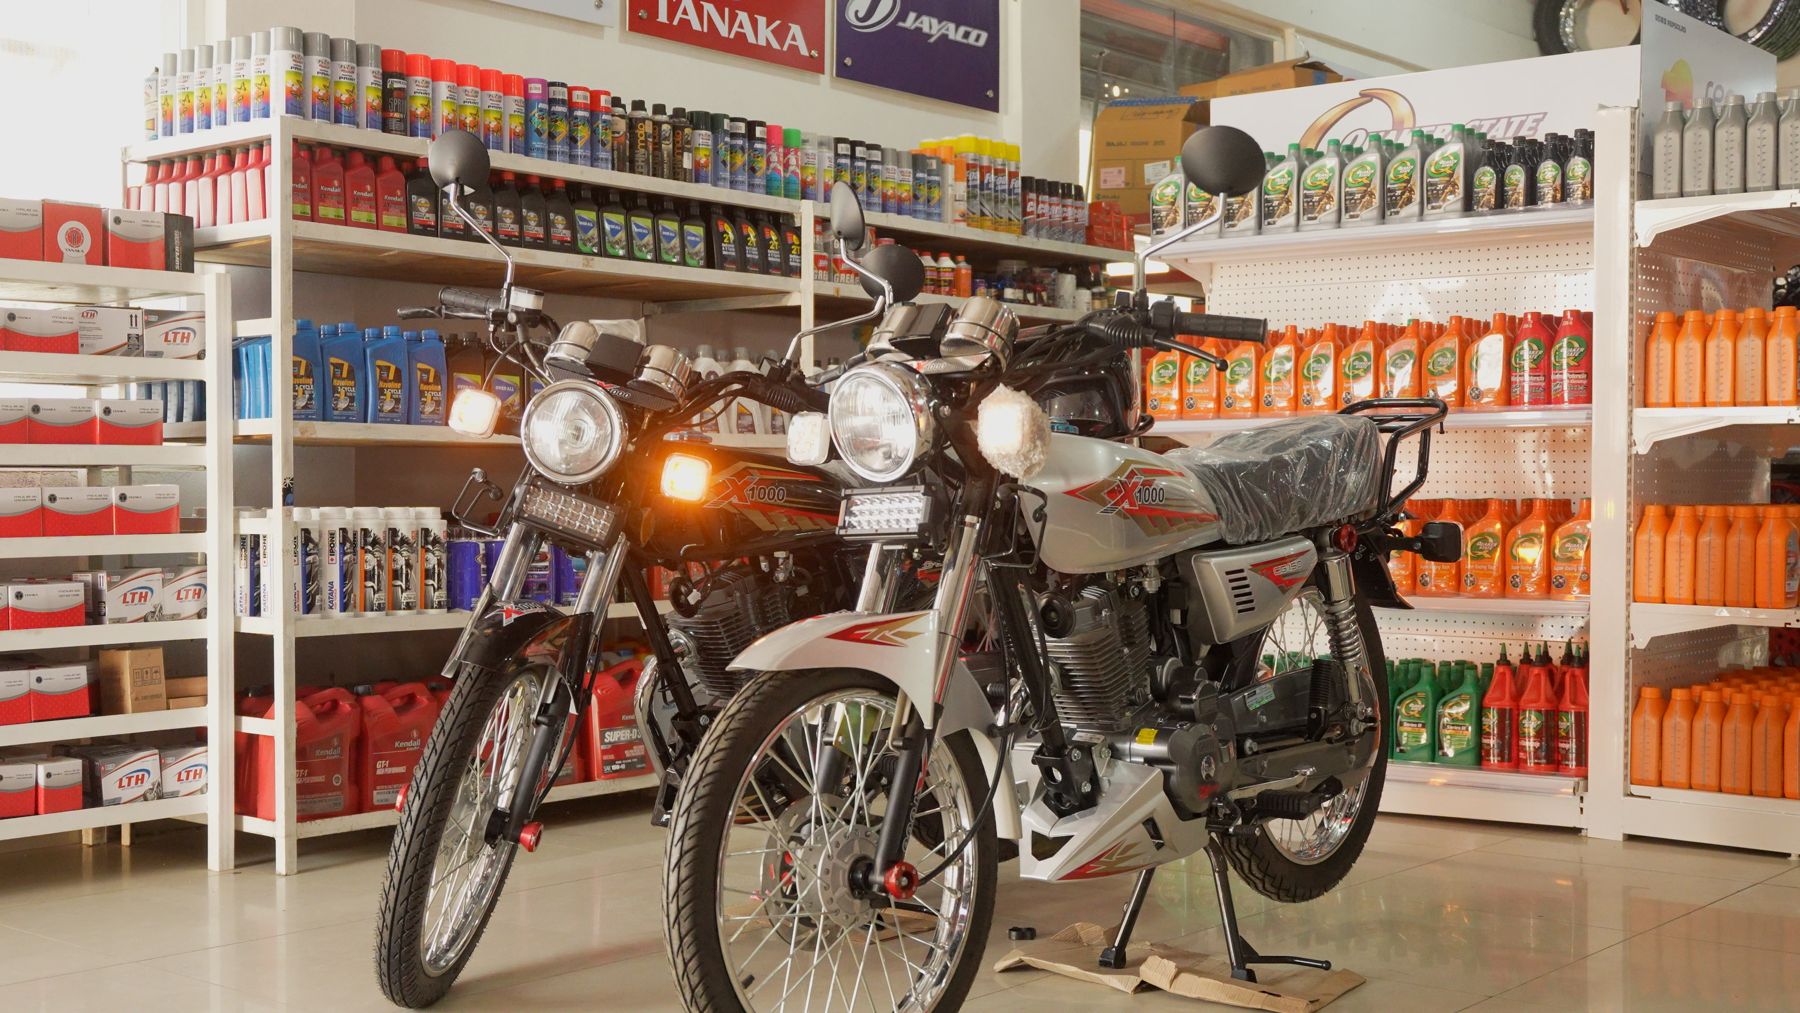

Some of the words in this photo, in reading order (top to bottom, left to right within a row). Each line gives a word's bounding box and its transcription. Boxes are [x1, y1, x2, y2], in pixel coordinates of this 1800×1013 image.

[656, 0, 810, 57] TANAKA
[896, 11, 989, 47] JAYACO
[747, 237, 757, 247] 2T
[769, 240, 780, 250] 2T
[81, 310, 97, 319] LTH
[163, 331, 193, 344] LTH
[1096, 475, 1165, 515] X1000
[328, 532, 336, 557] IPONE
[122, 591, 149, 604] LTH
[176, 588, 202, 601] LTH
[327, 580, 335, 610] KATANA
[604, 728, 637, 743] SUPER-D
[394, 738, 420, 748] Kendall
[315, 747, 341, 756] Kendall
[376, 760, 389, 769] GT-1
[117, 773, 146, 789] LTH
[176, 767, 203, 783] LTH
